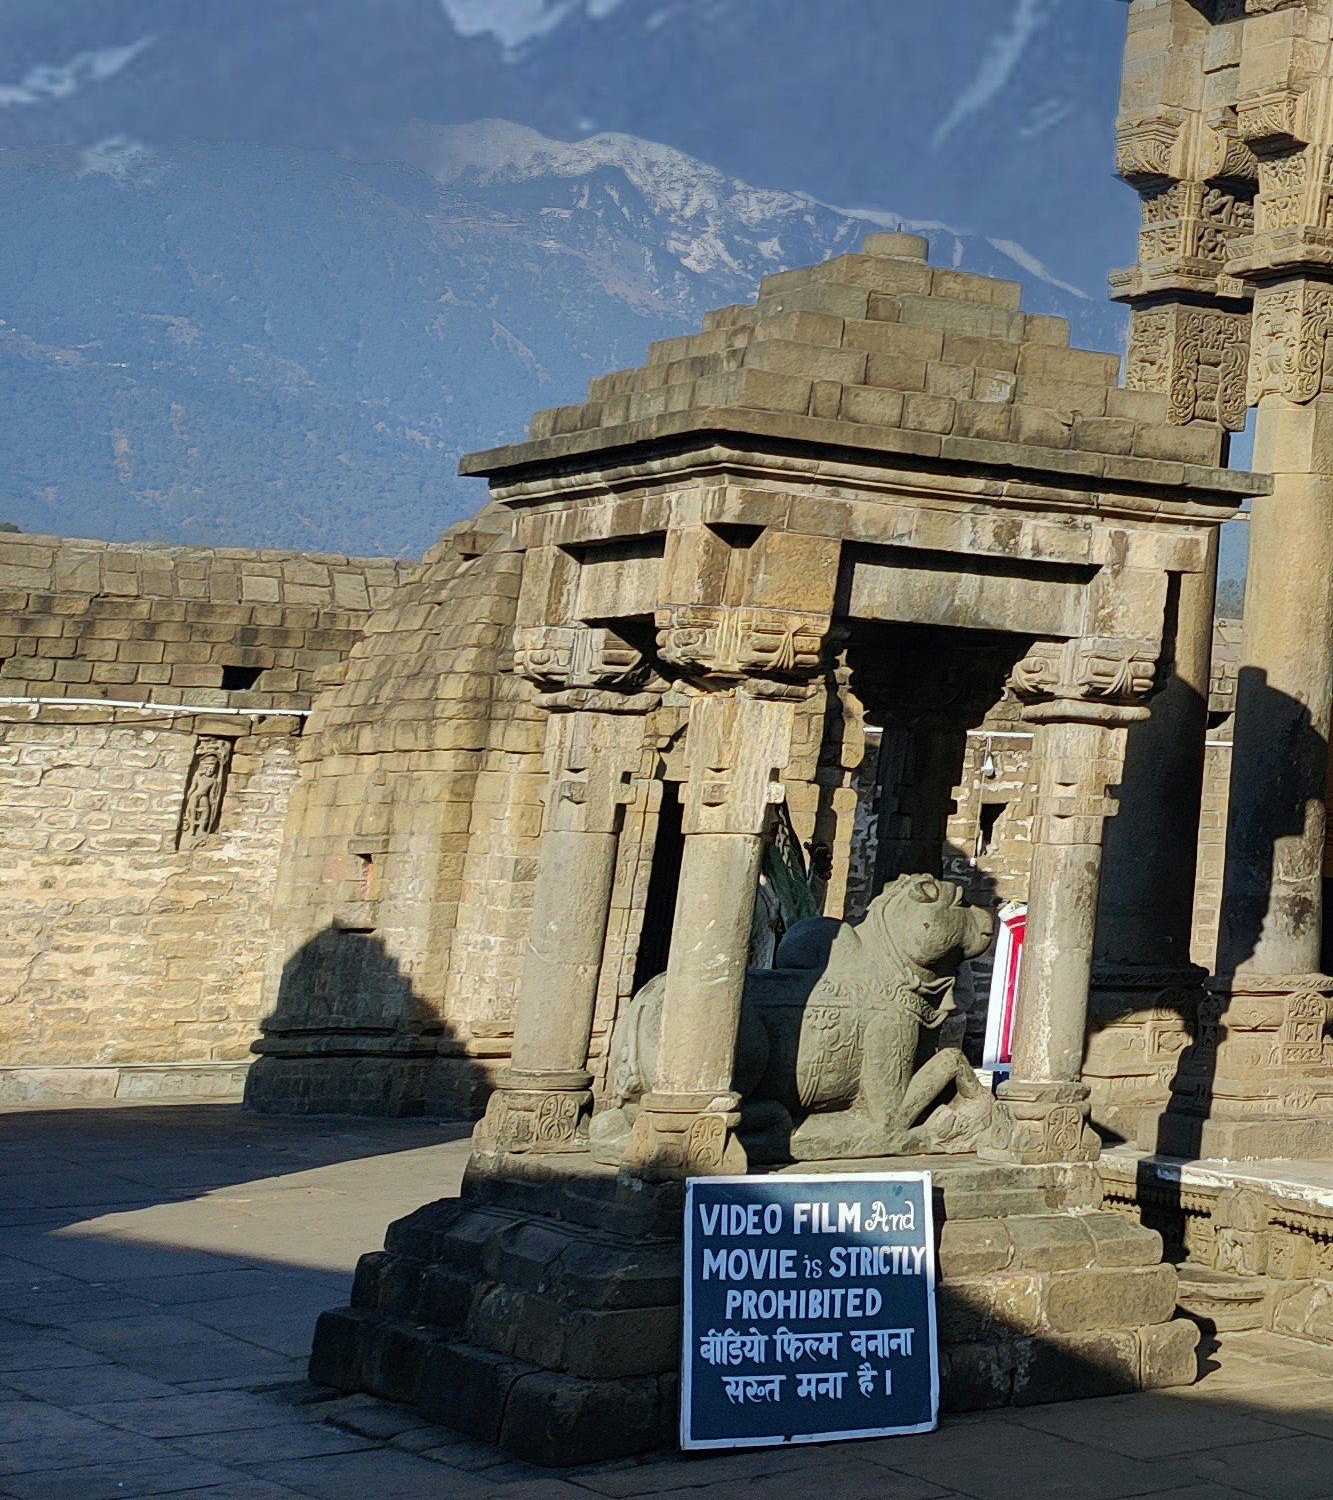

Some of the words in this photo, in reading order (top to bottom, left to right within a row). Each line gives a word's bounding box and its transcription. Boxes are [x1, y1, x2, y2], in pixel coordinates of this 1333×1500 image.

[699, 1203, 783, 1236] VIDEO
[793, 1202, 861, 1234] FILM
[864, 1200, 916, 1233] And
[702, 1248, 797, 1281] MOVIE
[803, 1254, 823, 1279] is
[829, 1245, 926, 1278] STRICTLY
[725, 1288, 883, 1320] PROHIBITED
[773, 1326, 843, 1363] फिल्म
[850, 1328, 915, 1359] बनाना
[795, 1372, 848, 1401] मना
